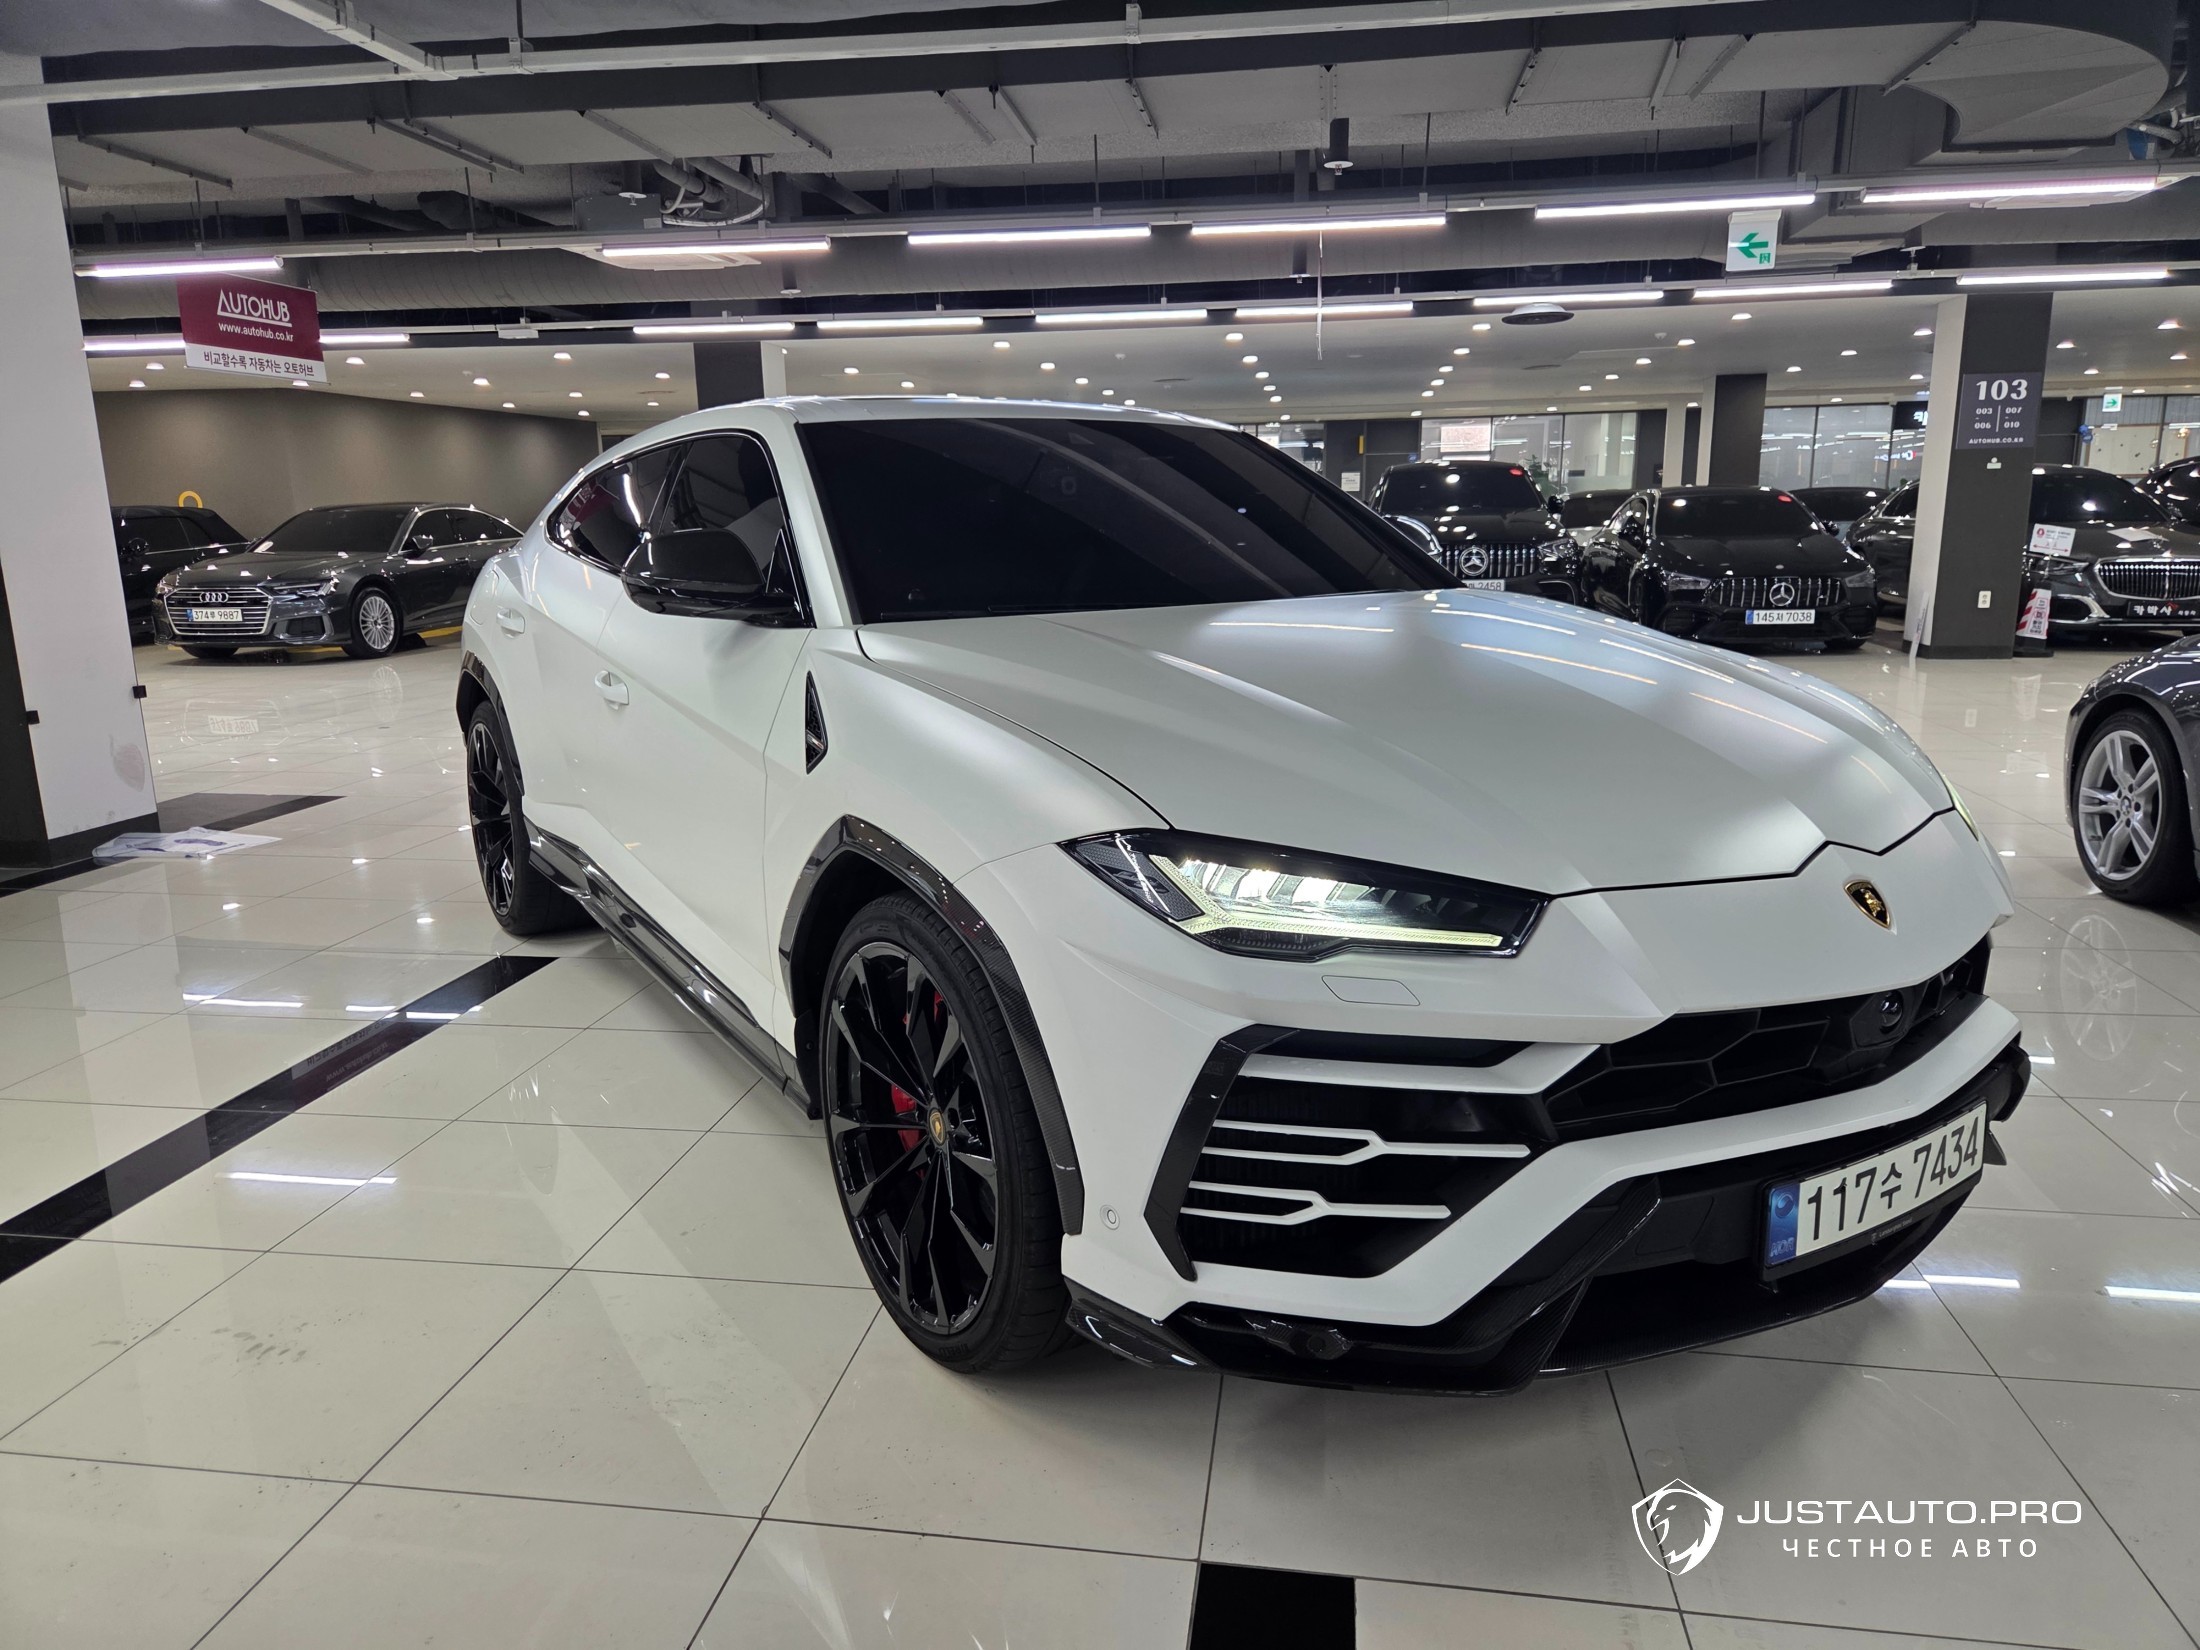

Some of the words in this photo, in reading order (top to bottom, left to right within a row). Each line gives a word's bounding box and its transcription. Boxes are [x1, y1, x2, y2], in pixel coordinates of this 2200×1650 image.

[217, 288, 291, 325] AUTOHUB
[218, 322, 294, 342] www.autohub.co.kr
[203, 351, 247, 369] 비교할수록
[249, 357, 282, 373] 자동차는
[283, 361, 315, 377] 오토허브
[1975, 379, 2028, 401] 103
[1975, 407, 1993, 415] 003
[2005, 406, 2023, 414] 007
[217, 610, 239, 620] 9887
[1785, 611, 1812, 622] 7038
[1807, 1161, 1903, 1241] 117수
[1912, 1115, 1979, 1200] 7434
